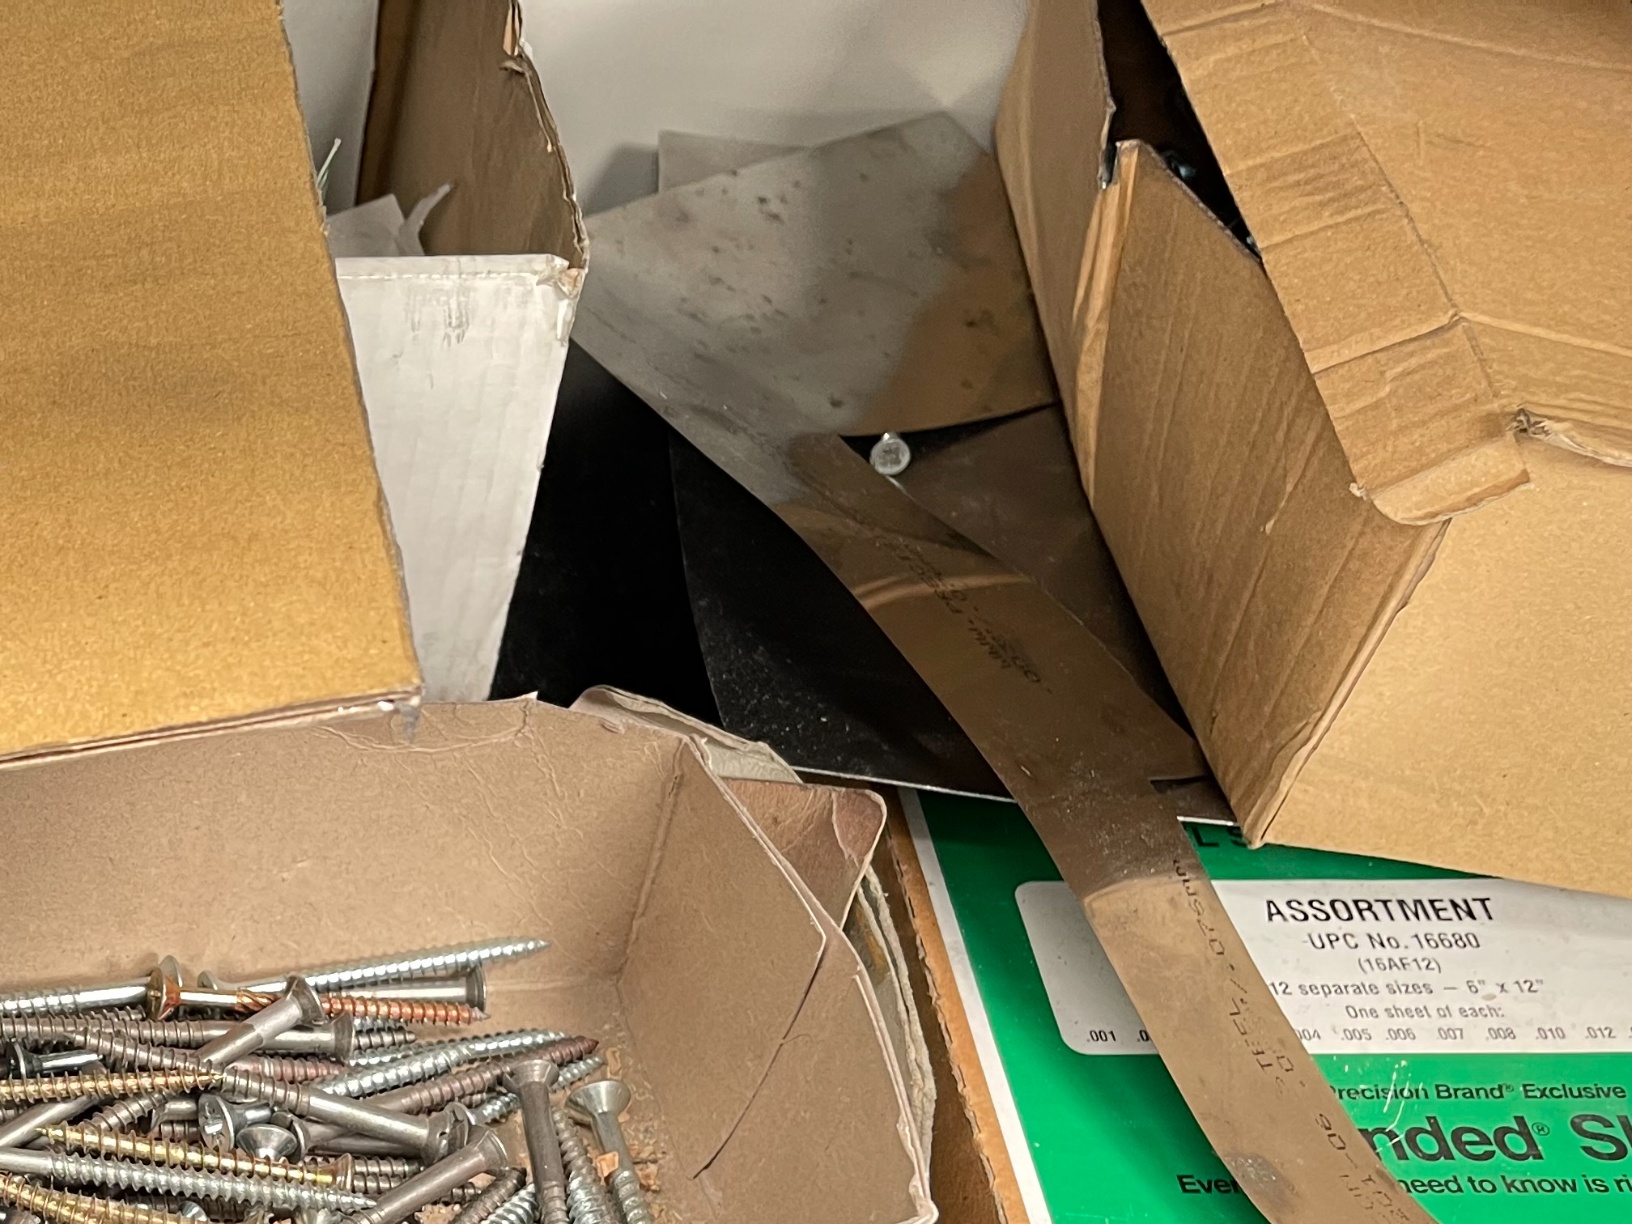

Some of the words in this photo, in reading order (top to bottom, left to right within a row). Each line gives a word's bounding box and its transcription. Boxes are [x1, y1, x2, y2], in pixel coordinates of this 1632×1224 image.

[1265, 896, 1497, 923] ASSORTMENT
[1308, 932, 1360, 951] UPC
[1356, 956, 1443, 975] (16AF12)
[1297, 980, 1380, 999] separate
[1385, 979, 1433, 997] sizes
[1495, 982, 1508, 995] x
[1345, 1003, 1379, 1020] One
[1383, 1003, 1431, 1020] sheet
[1437, 1003, 1464, 1020] of
[1467, 1003, 1506, 1021] each:
[1086, 1029, 1117, 1043] .001
[1385, 1026, 1417, 1042] .006
[1534, 1026, 1567, 1042] .010
[1584, 1026, 1617, 1042] .012
[1521, 1082, 1627, 1100] Exclusive
[1397, 1174, 1462, 1194] need
[1467, 1175, 1497, 1194] to
[1501, 1174, 1578, 1194] know
[1581, 1174, 1611, 1194] is
